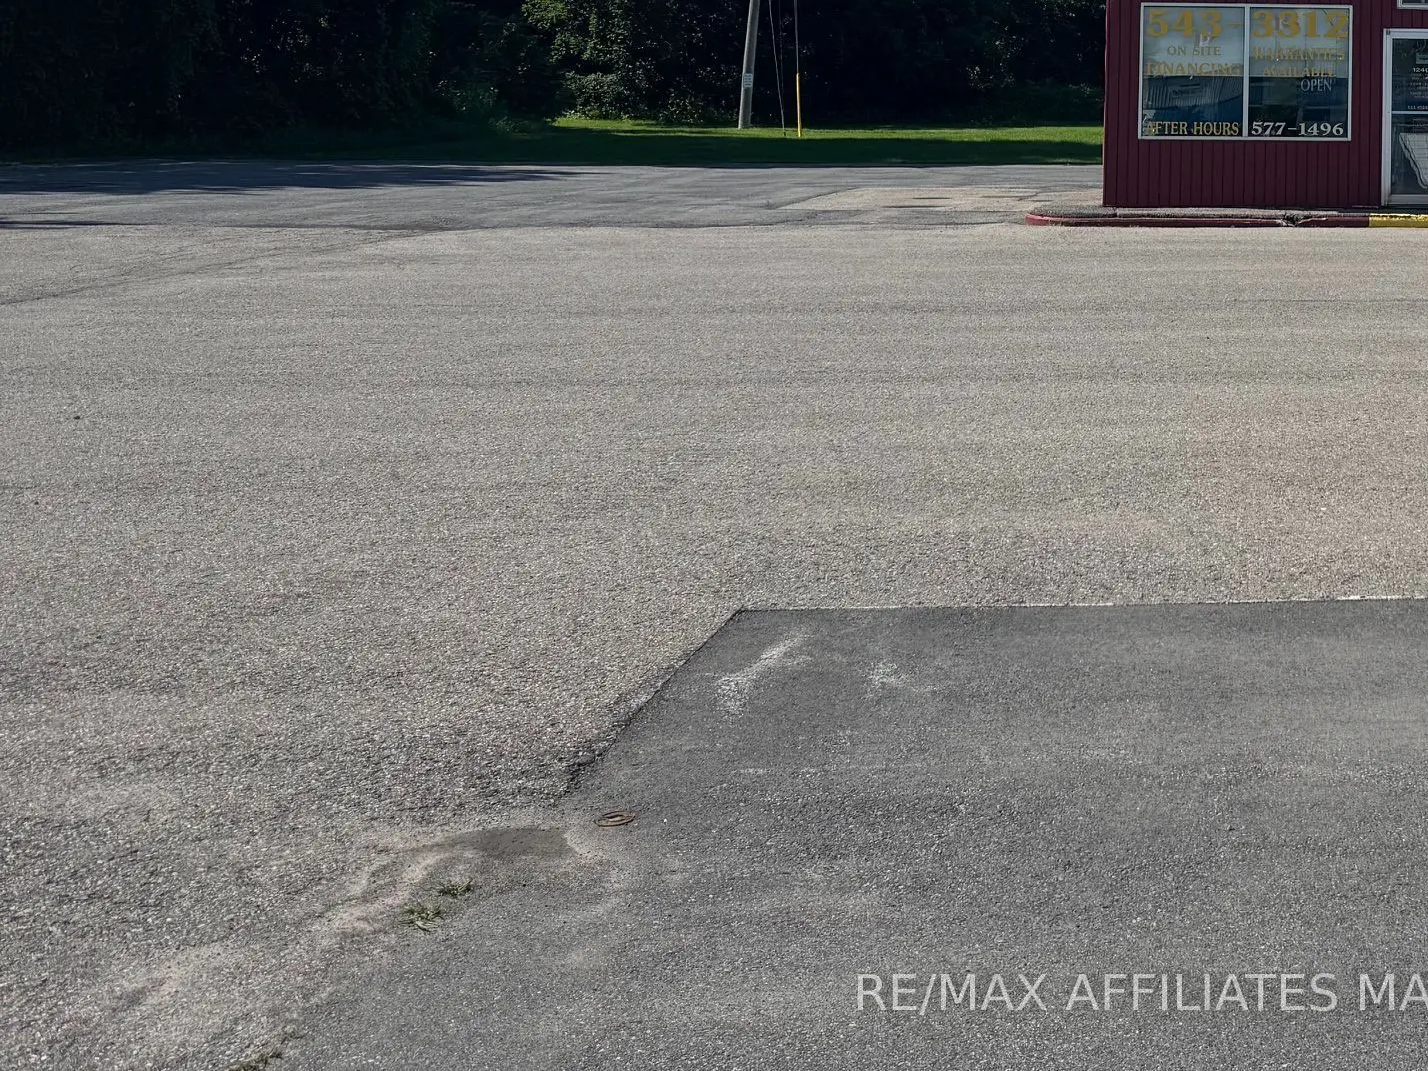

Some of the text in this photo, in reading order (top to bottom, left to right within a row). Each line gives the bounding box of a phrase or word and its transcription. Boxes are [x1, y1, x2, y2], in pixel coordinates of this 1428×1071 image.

[1166, 46, 1223, 57] ON SITE
[1300, 78, 1333, 92] OPEN
[1146, 120, 1344, 137] AFTER HOURS 577-1496
